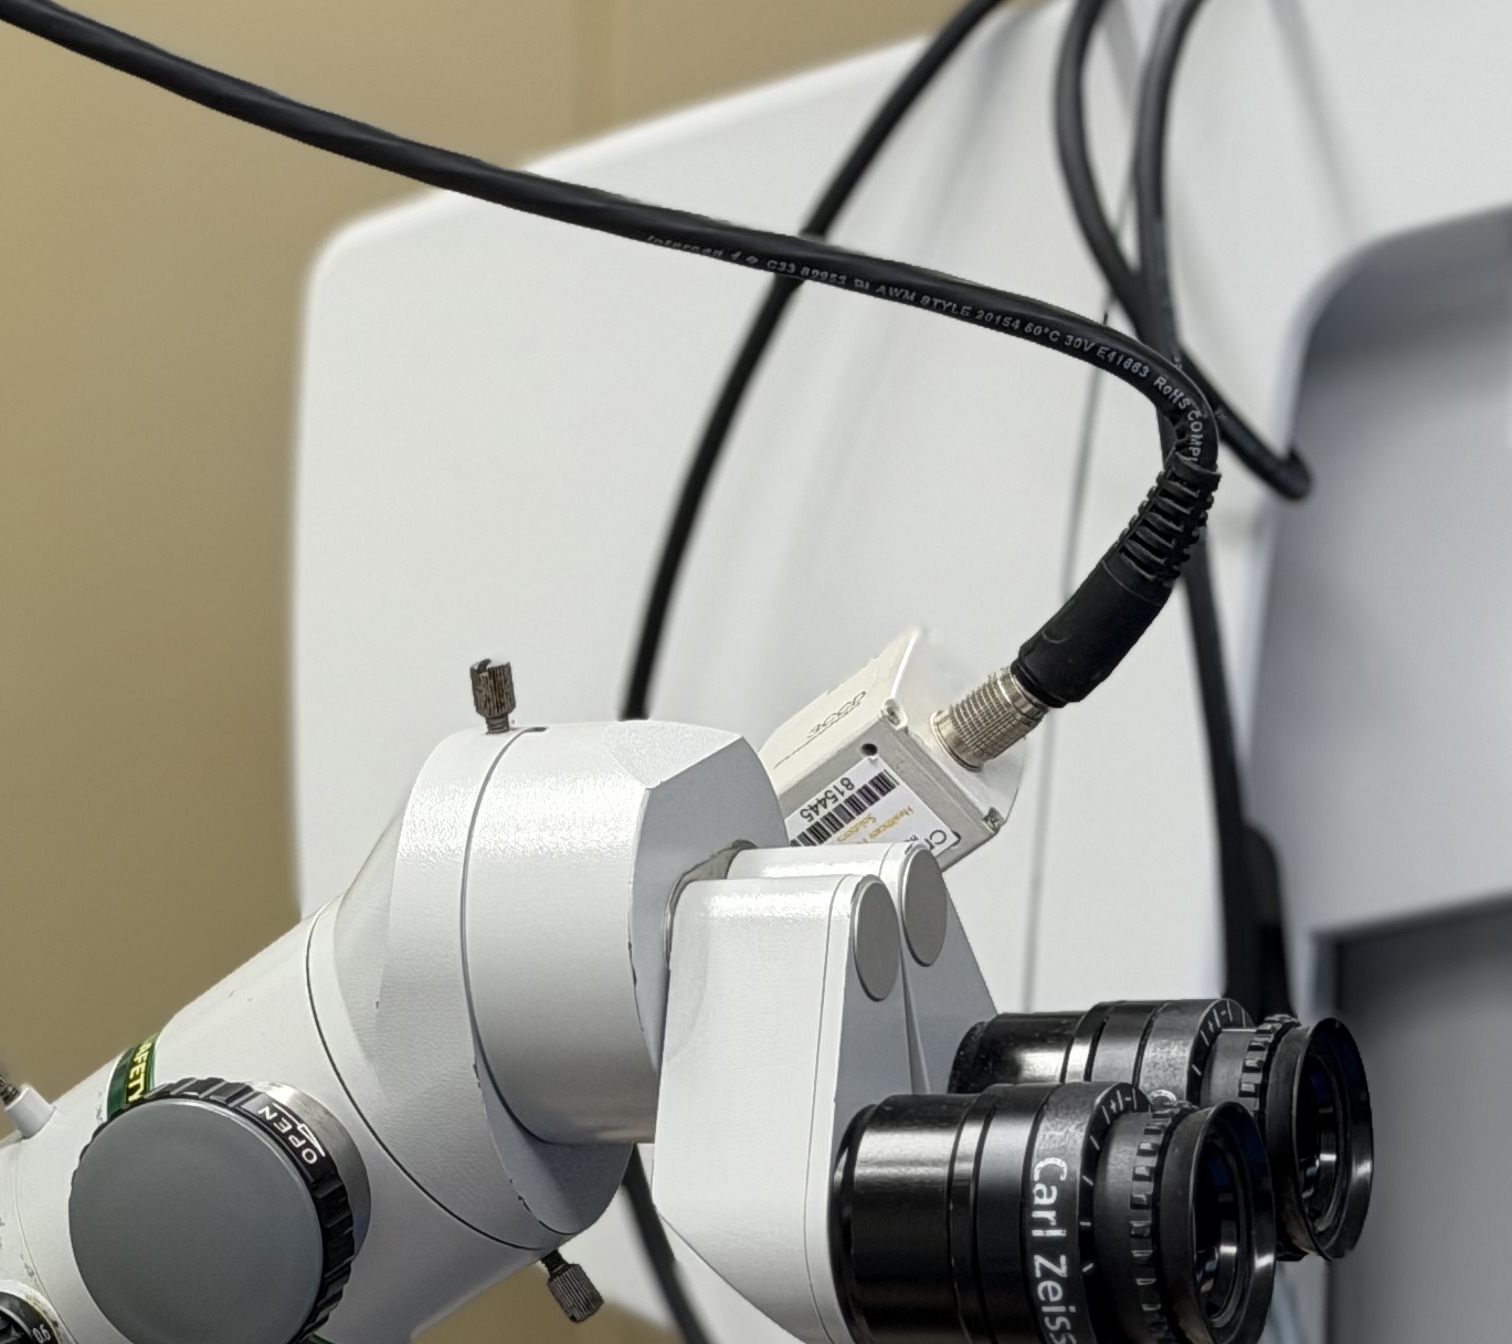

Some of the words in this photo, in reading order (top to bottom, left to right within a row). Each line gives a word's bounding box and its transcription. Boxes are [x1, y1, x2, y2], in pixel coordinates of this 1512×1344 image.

[1152, 375, 1190, 410] RoHS
[799, 776, 856, 823] 815445
[127, 1037, 154, 1103] AFETY
[257, 1105, 318, 1165] OPEN
[1031, 1156, 1068, 1238] Carl
